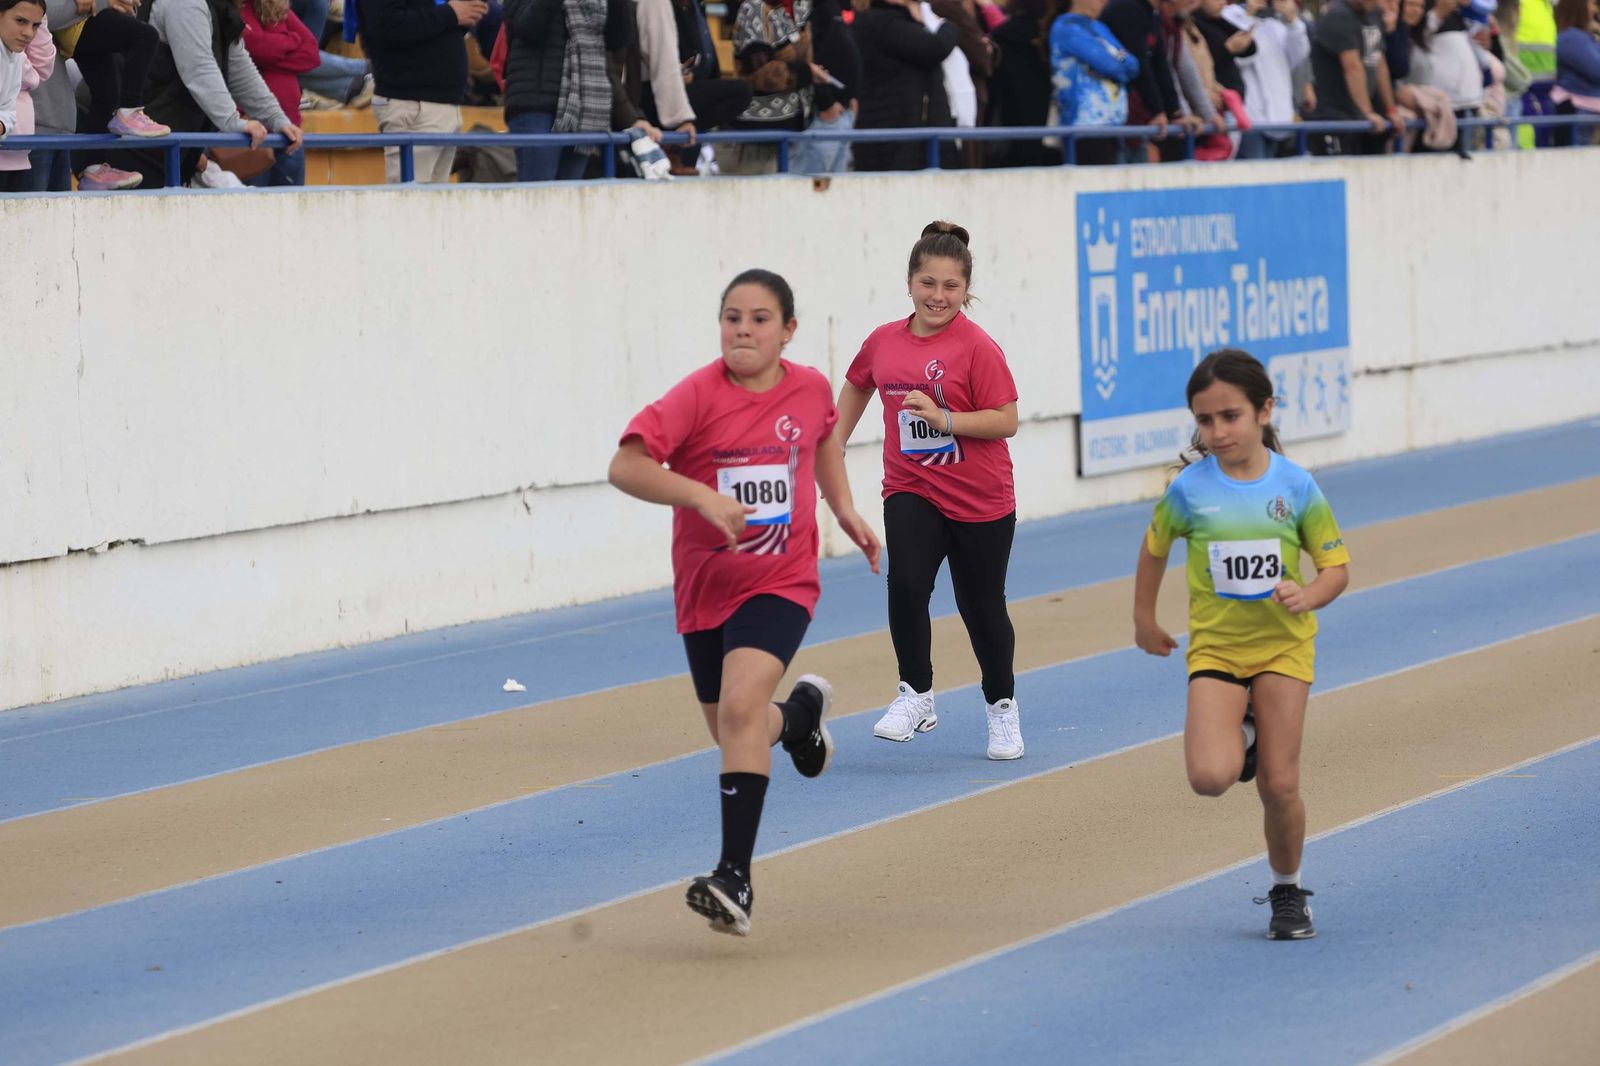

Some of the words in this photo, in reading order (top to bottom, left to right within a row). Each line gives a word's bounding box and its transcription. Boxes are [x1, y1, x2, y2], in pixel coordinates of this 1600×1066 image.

[1131, 217, 1177, 258] ESTADIO
[1179, 213, 1239, 253] MUNICIPAL
[1132, 265, 1230, 366] Enrique
[1231, 257, 1328, 342] Talavera
[731, 480, 787, 505] 1080
[1222, 554, 1279, 580] 1023
